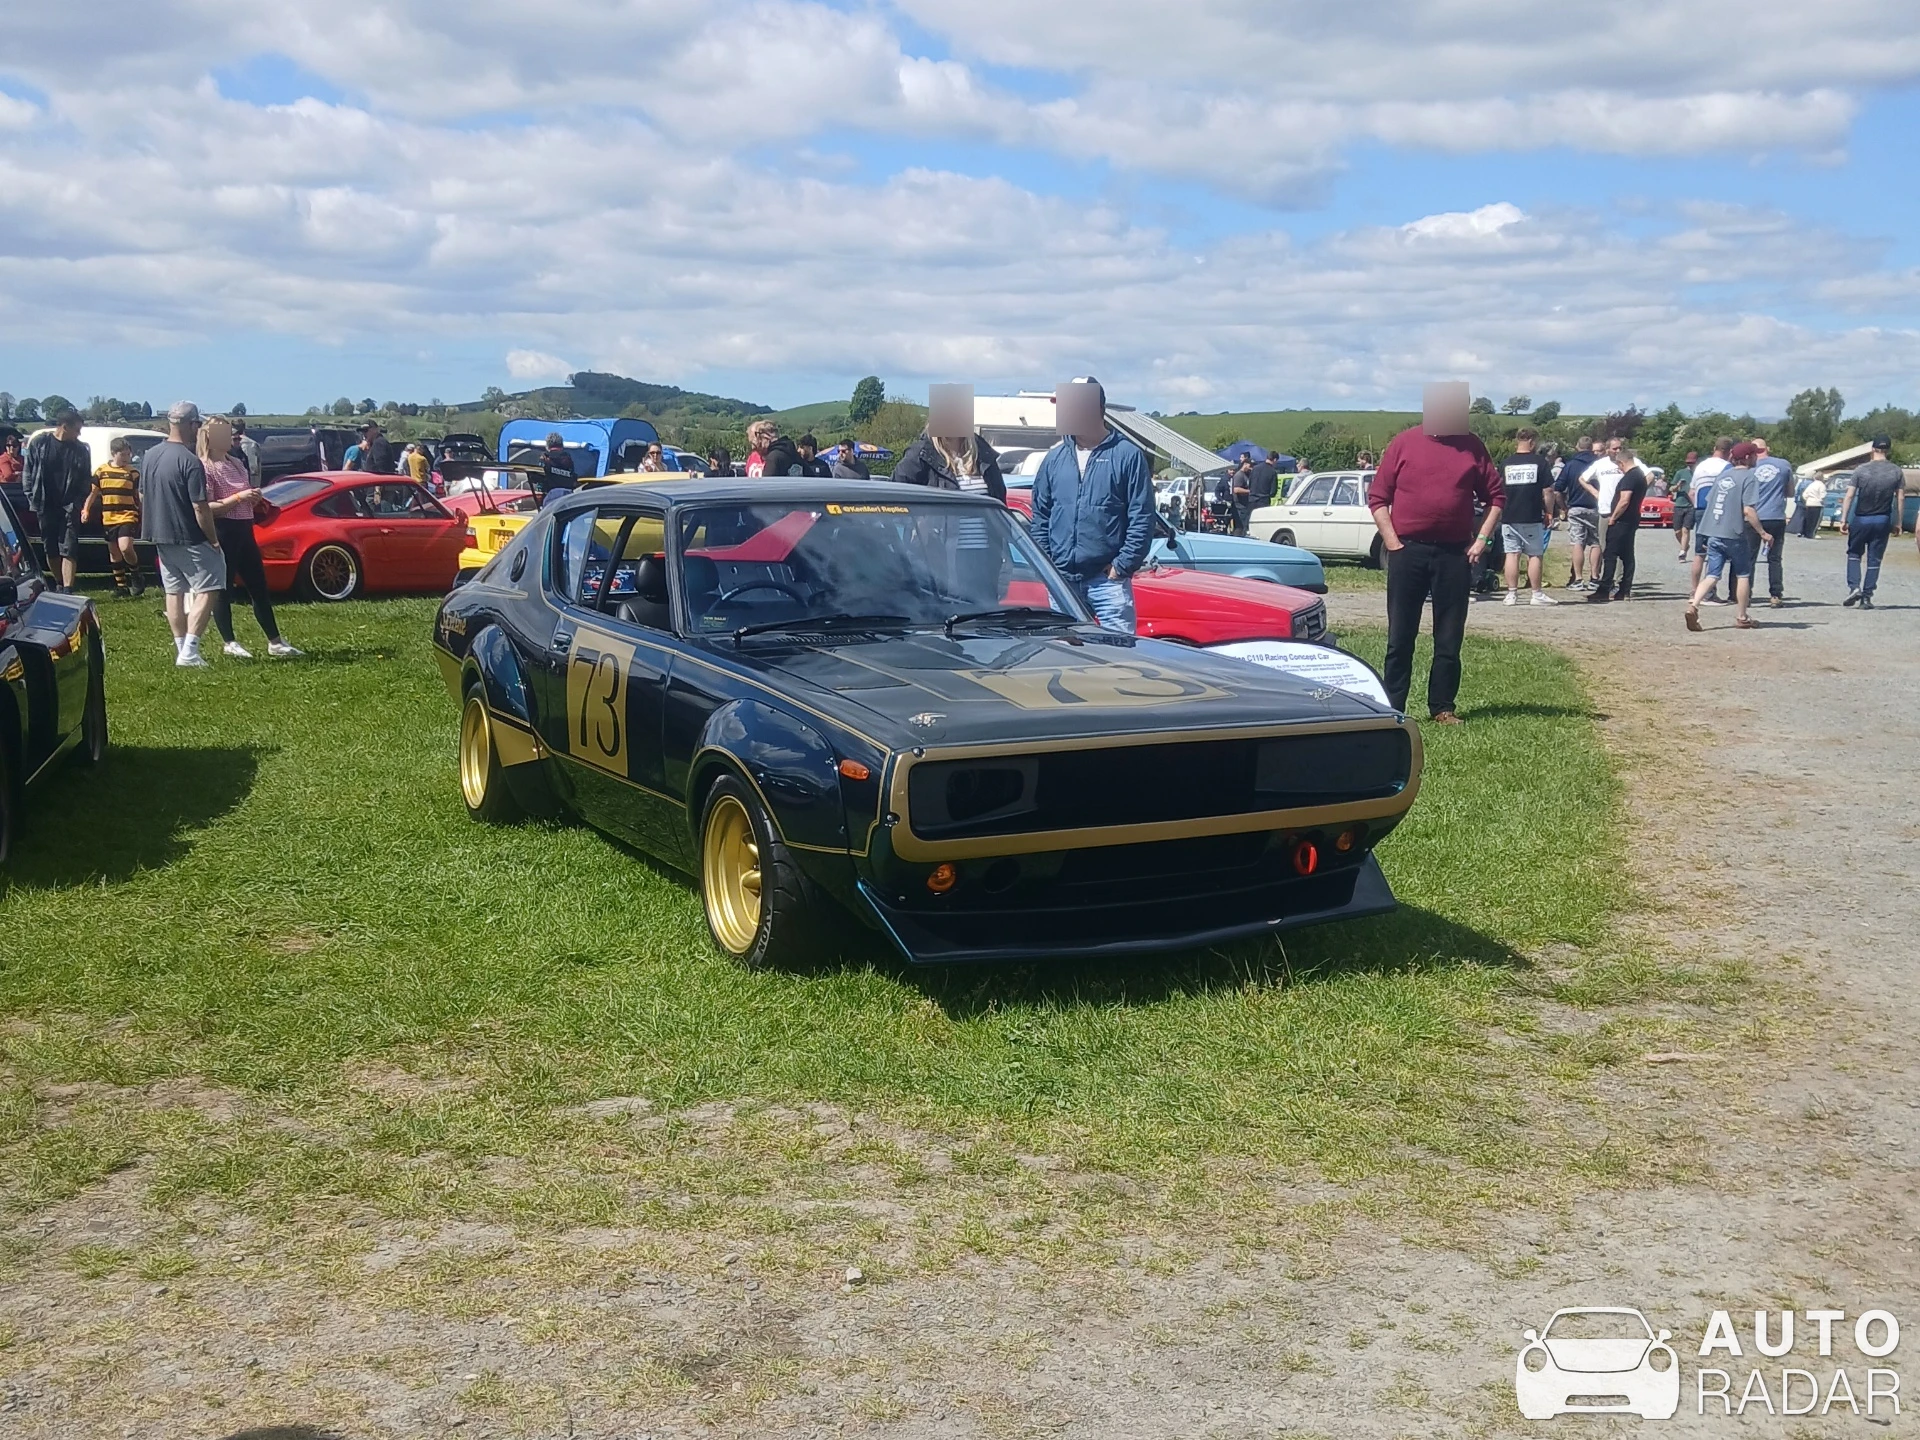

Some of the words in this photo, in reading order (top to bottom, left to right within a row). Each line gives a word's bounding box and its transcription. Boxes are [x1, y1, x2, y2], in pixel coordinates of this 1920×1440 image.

[881, 505, 909, 514] Replica
[1246, 653, 1264, 662] C110
[1265, 653, 1288, 662] Racing
[1289, 653, 1317, 661] Concept
[573, 646, 620, 757] 73
[970, 663, 1207, 704] 73
[757, 905, 772, 955] AVON
